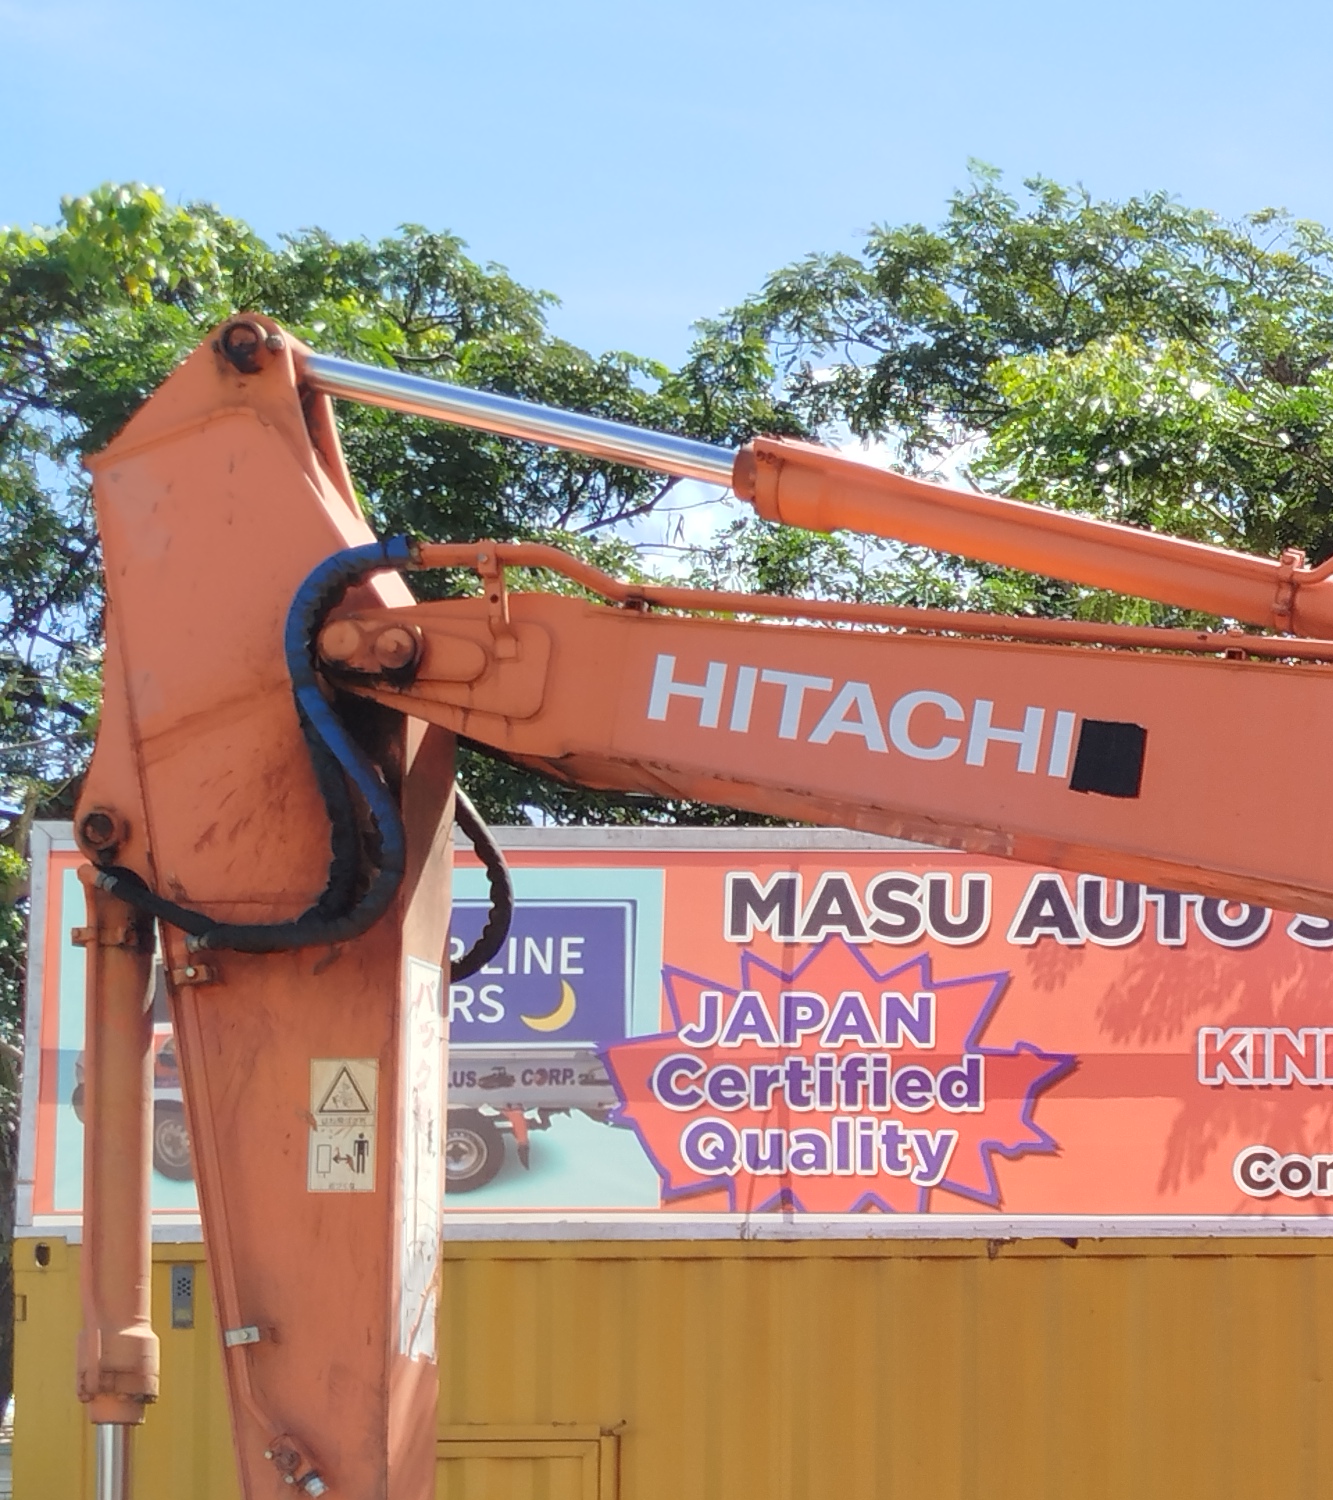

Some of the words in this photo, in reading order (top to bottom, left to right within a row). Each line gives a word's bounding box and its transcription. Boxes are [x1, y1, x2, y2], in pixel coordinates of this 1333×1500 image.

[647, 654, 1077, 779] HITACHI
[726, 872, 991, 943] MASU
[1008, 873, 1271, 945] AUTO
[679, 991, 935, 1048] JAPAN
[652, 1054, 985, 1113] Certified
[680, 1116, 958, 1187] Quality
